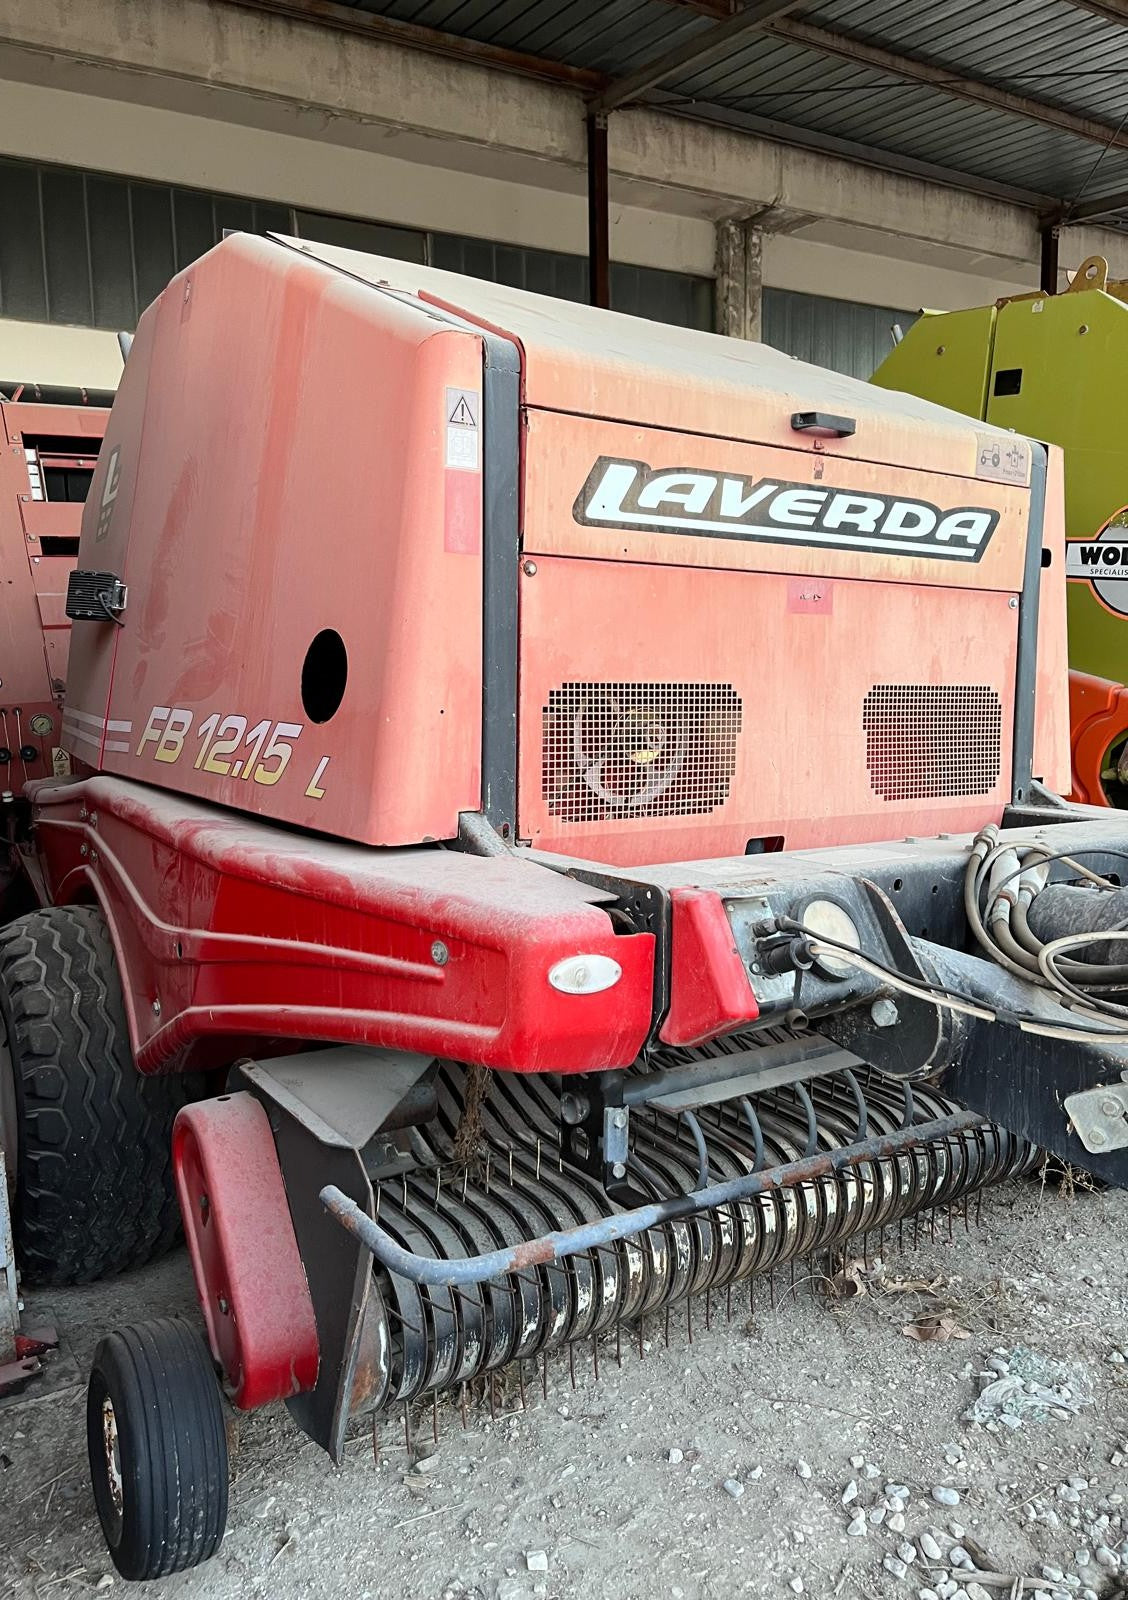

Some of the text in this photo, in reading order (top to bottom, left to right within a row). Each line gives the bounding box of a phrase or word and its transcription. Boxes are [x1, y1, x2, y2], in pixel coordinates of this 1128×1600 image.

[585, 463, 992, 548] LAVERDA
[136, 706, 330, 799] FB 12.15 L
